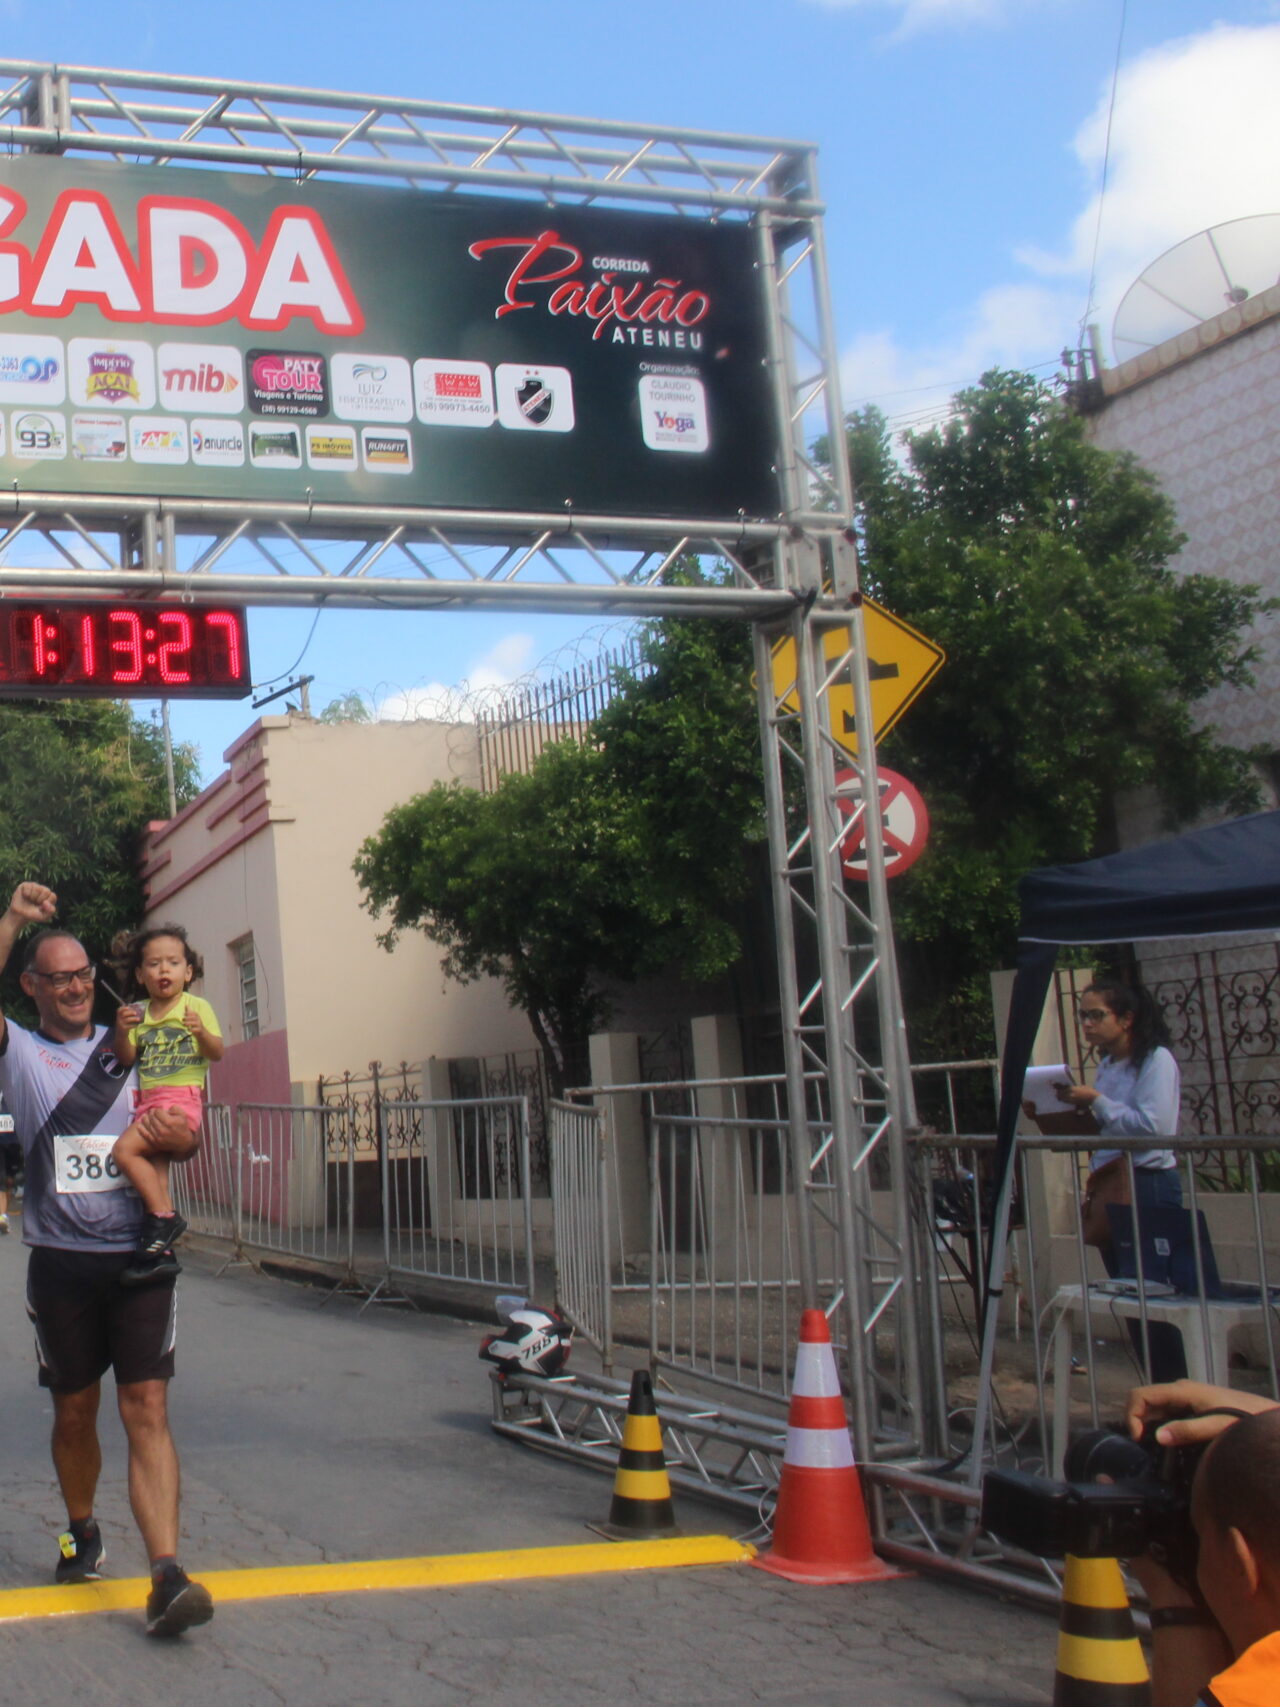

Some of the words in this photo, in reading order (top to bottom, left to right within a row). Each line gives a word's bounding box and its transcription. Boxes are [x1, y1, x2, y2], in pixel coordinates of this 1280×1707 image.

[591, 256, 651, 274] CORRIDA
[468, 230, 711, 341] Paixão
[611, 326, 704, 350] ATENEU
[283, 358, 322, 372] PATY
[162, 363, 226, 393] mib
[262, 368, 324, 393] TOUR
[254, 389, 285, 400] Viagens
[292, 391, 324, 402] Turismo
[654, 411, 696, 433] Yoga
[66, 1153, 122, 1180] 386
